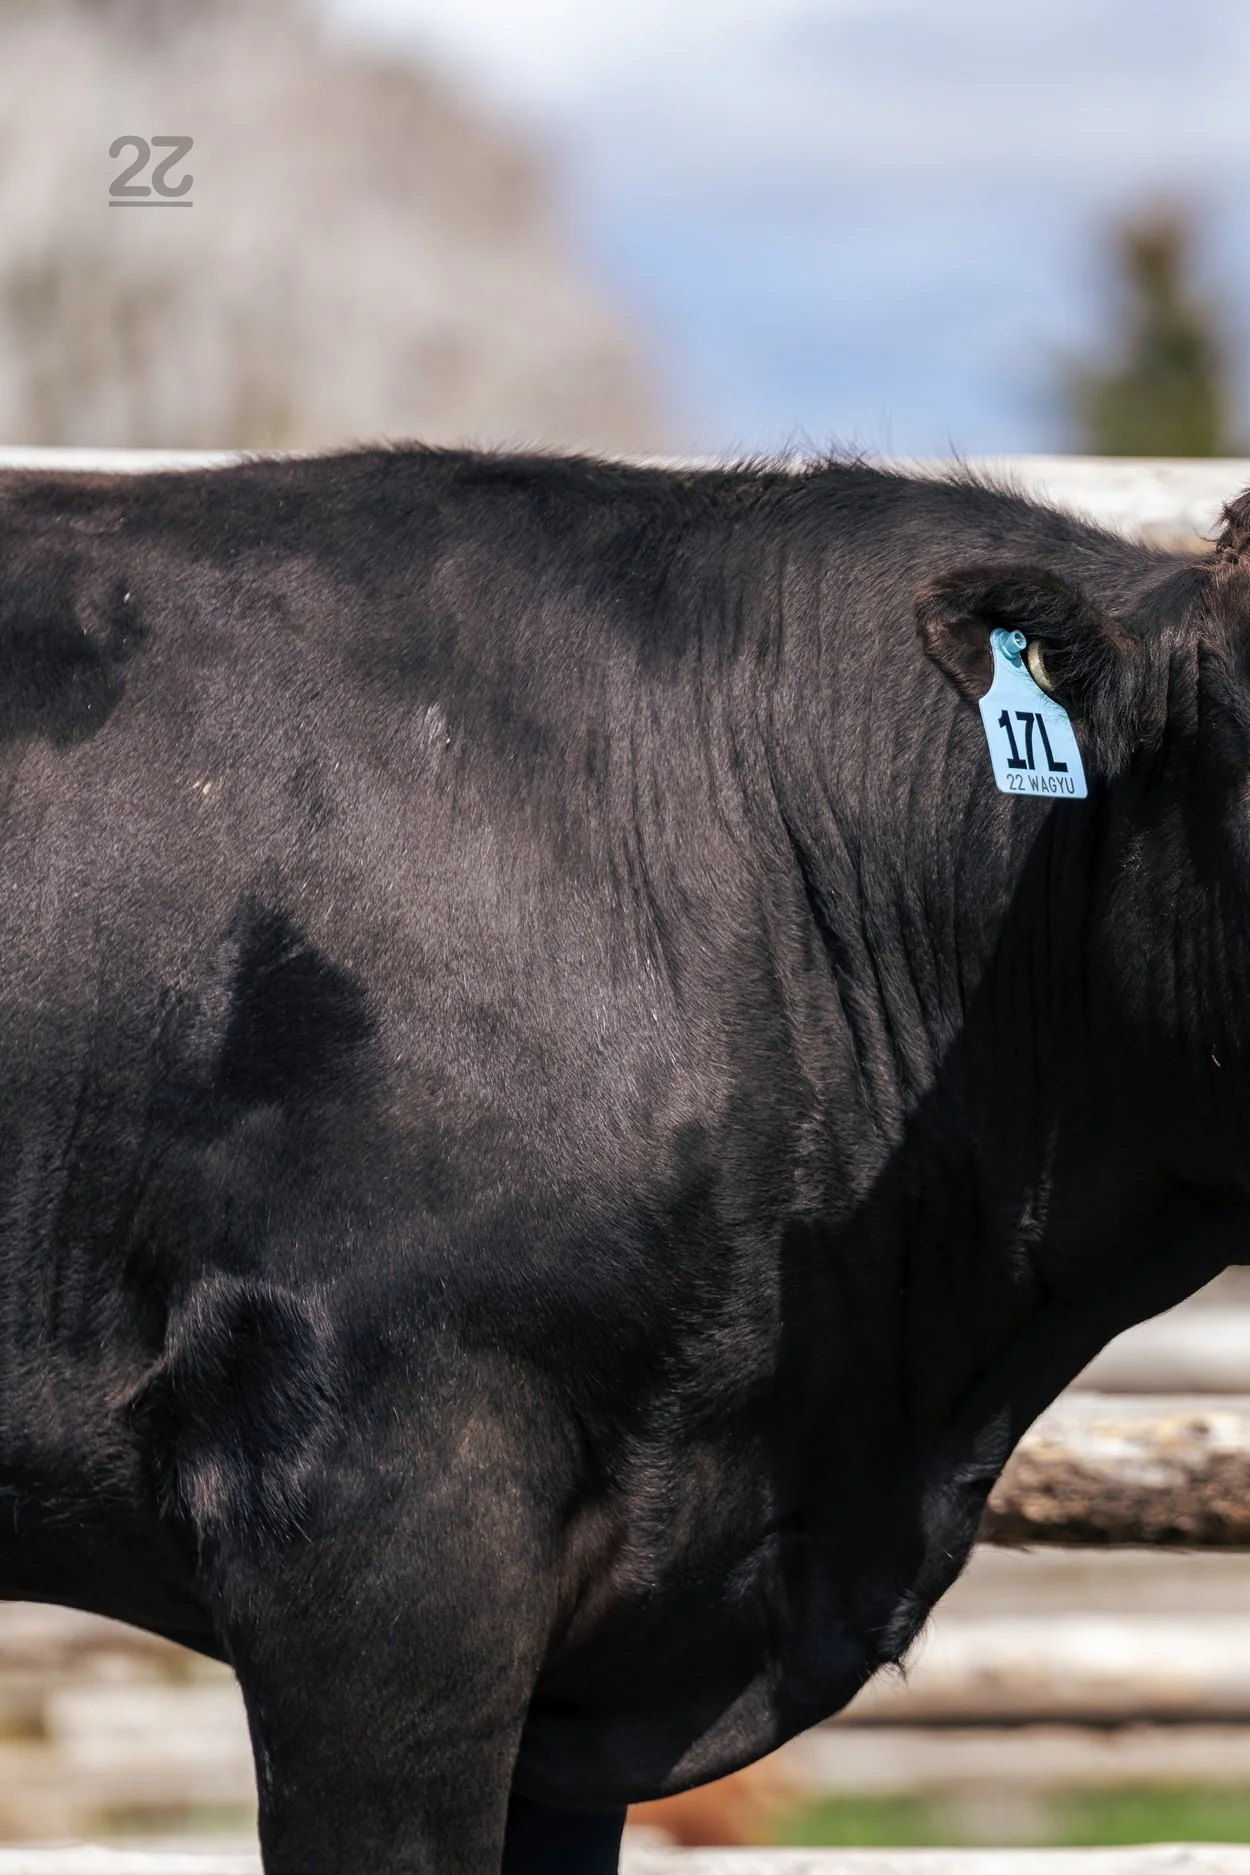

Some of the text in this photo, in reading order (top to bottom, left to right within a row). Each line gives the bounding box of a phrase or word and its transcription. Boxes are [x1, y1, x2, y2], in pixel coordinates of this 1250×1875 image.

[998, 710, 1068, 772] 17L
[1006, 774, 1075, 794] 22 WAGYU
